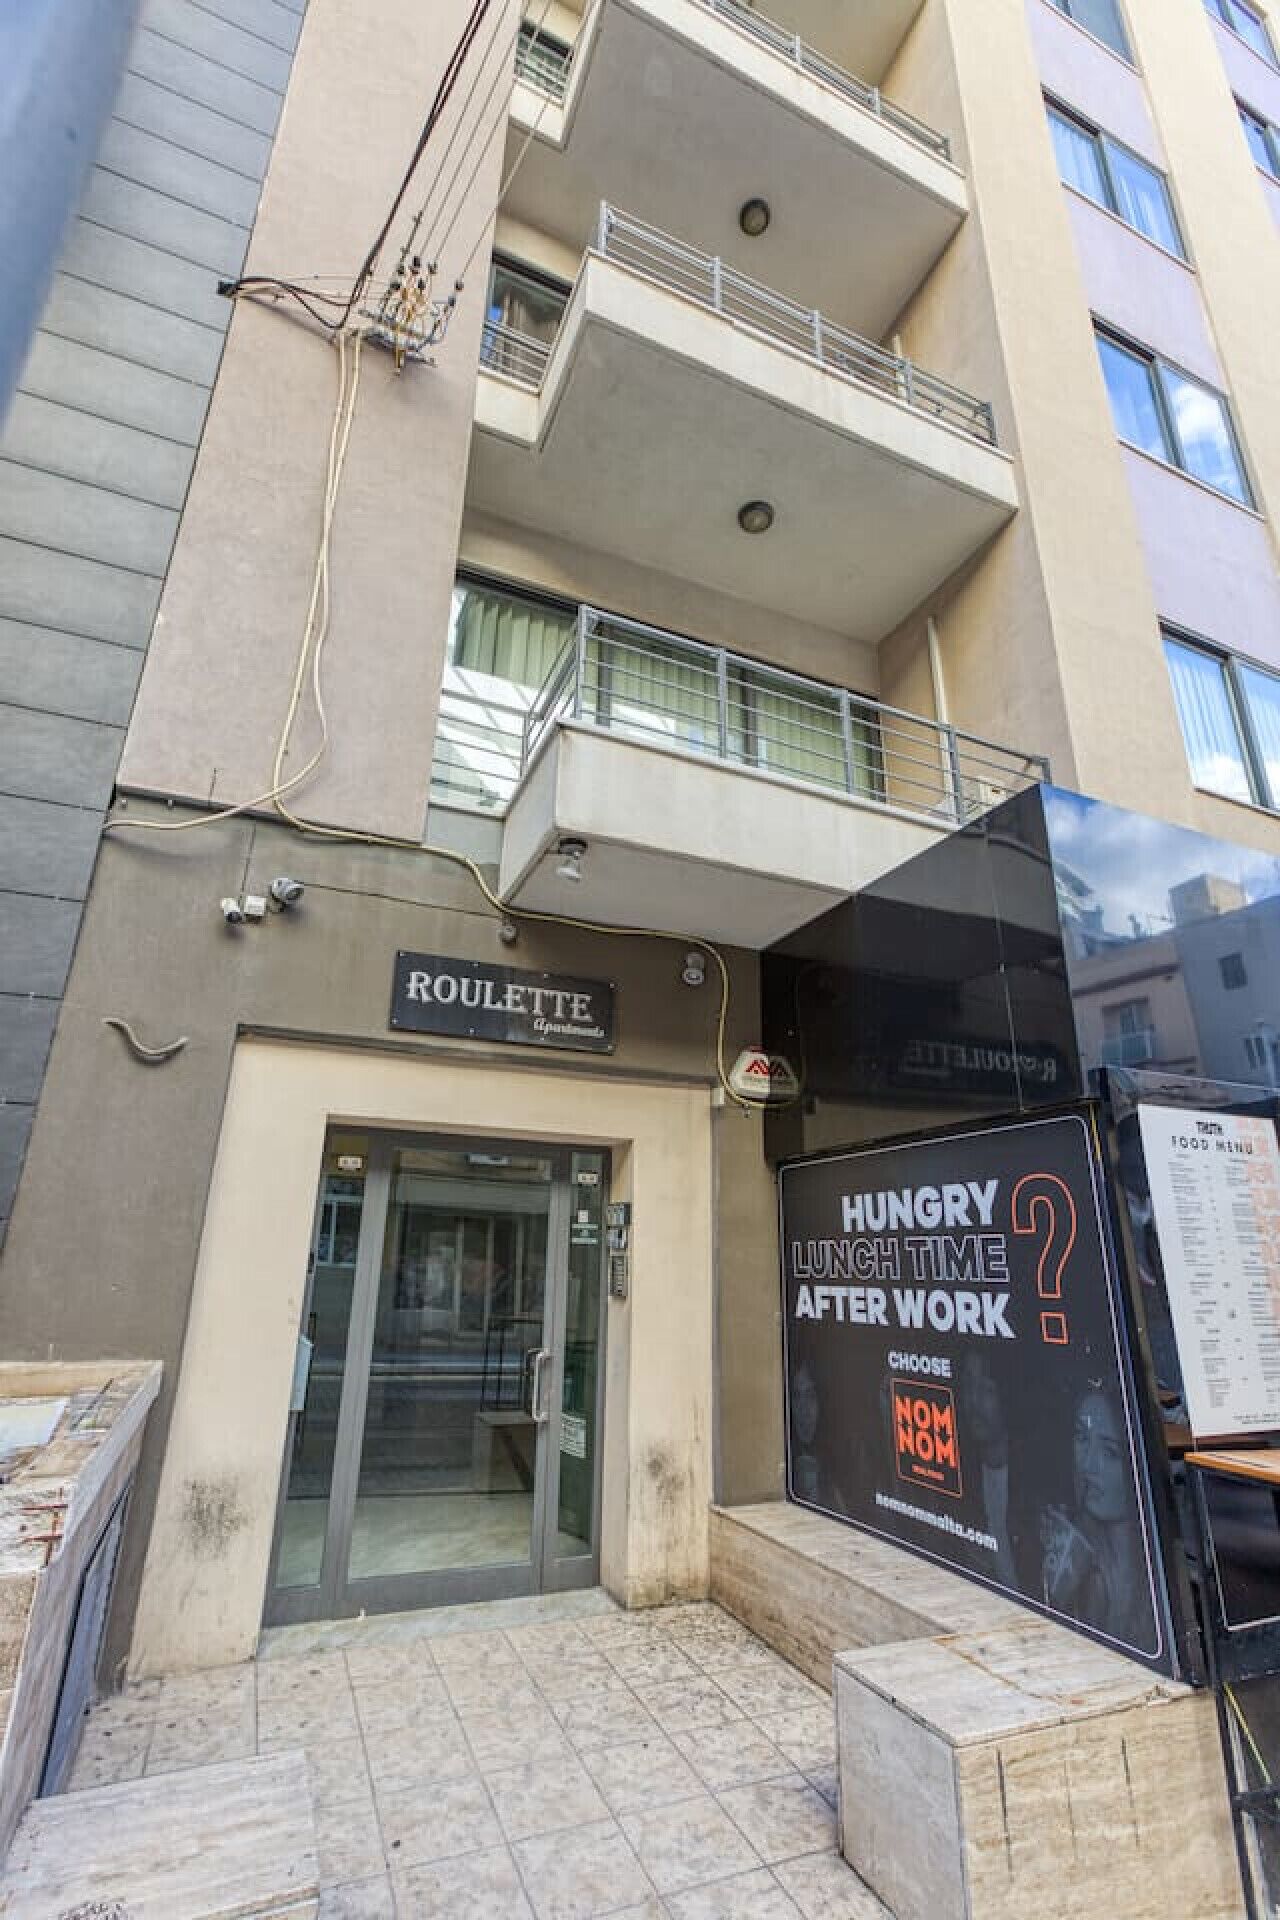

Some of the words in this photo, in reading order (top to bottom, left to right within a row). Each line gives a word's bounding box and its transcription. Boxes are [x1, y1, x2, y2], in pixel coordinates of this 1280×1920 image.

[406, 970, 593, 1022] ROULETTE
[841, 1179, 999, 1233] HUNGRY
[793, 1236, 900, 1279] LUNCH
[904, 1233, 1009, 1283] TIME
[794, 1285, 890, 1325] AFTER
[894, 1289, 1015, 1339] WORK
[887, 1351, 951, 1377] CHOOSE
[894, 1394, 953, 1432] NOM
[896, 1425, 957, 1467] NOM
[875, 1493, 998, 1552] nomnommalta.com
